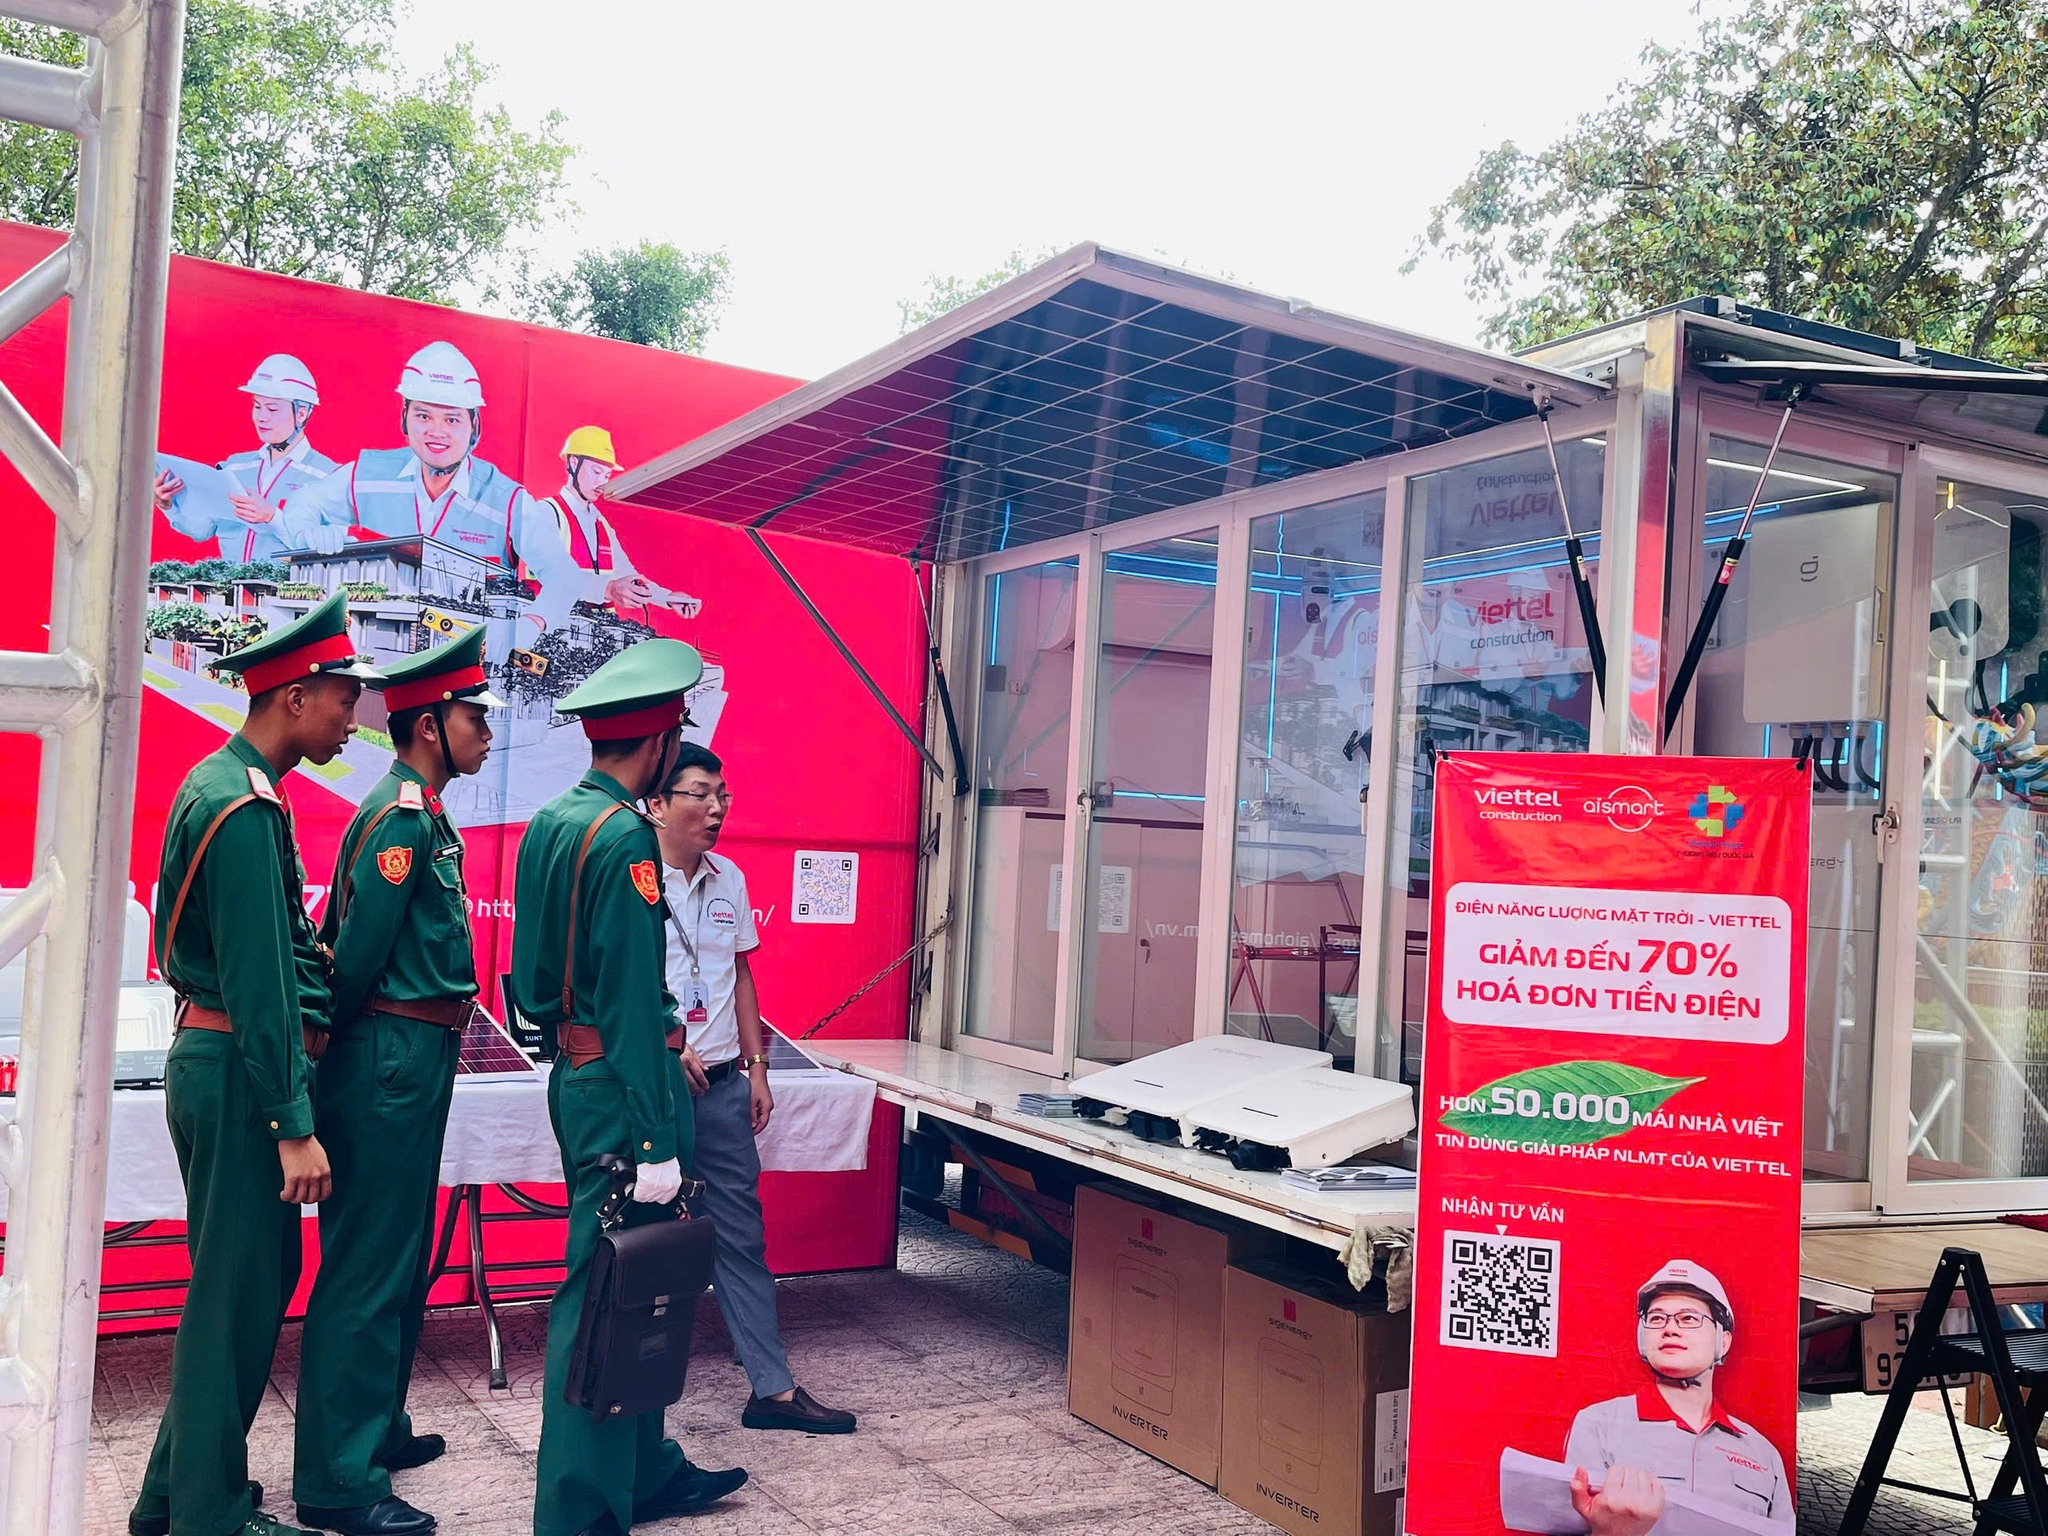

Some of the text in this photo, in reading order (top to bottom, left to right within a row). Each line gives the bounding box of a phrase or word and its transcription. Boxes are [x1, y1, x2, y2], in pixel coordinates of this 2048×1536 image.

[1465, 593, 1554, 627] viettel
[1470, 630, 1554, 649] construction
[1474, 787, 1562, 807] viettel
[1583, 798, 1664, 816] aismart
[1479, 810, 1562, 822] construction
[1455, 899, 1494, 916] ĐIỆN
[1497, 901, 1545, 917] NĂNG
[1549, 906, 1607, 921] LƯỢNG
[1611, 908, 1650, 924] MẶT
[1653, 909, 1693, 925] TRỜI
[1708, 914, 1781, 929] VIETTEL
[1479, 938, 1738, 978] GIẢM ĐẾN 70%
[1457, 976, 1760, 1021] HOÁ ĐƠN TIỀN ĐIỆN
[1439, 1086, 1783, 1139] HƠN 50.000 MÁI NHÀ VIỆT
[1435, 1133, 1791, 1176] TIN DÙNG GIẢI PHÁP NLMT CỦA VIETTEL
[1441, 1196, 1564, 1223] NHẬN TƯ VẤN
[1112, 1404, 1168, 1441] INVERTER
[1256, 1482, 1320, 1524] INVERTER
